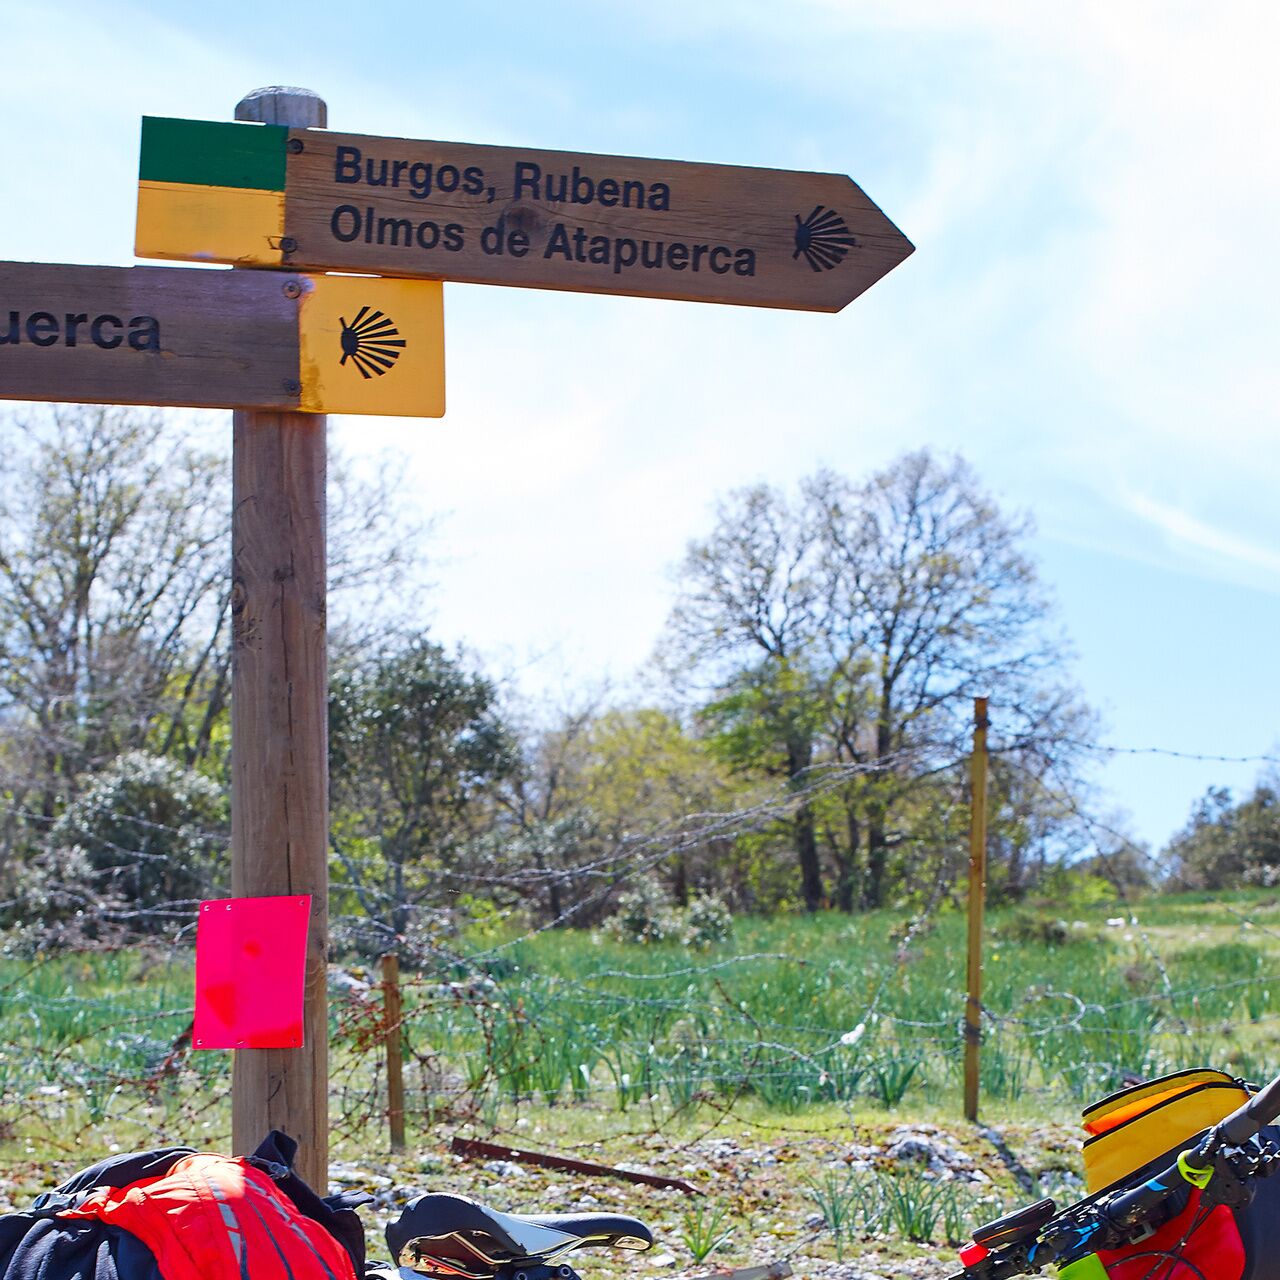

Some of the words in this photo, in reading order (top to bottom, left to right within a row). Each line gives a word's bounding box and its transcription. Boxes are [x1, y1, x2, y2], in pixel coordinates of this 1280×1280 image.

[334, 145, 497, 204] Burgos,
[513, 161, 671, 212] Rubena
[330, 204, 465, 252] Olmos
[481, 211, 530, 258] de
[543, 222, 757, 277] Atapuerca
